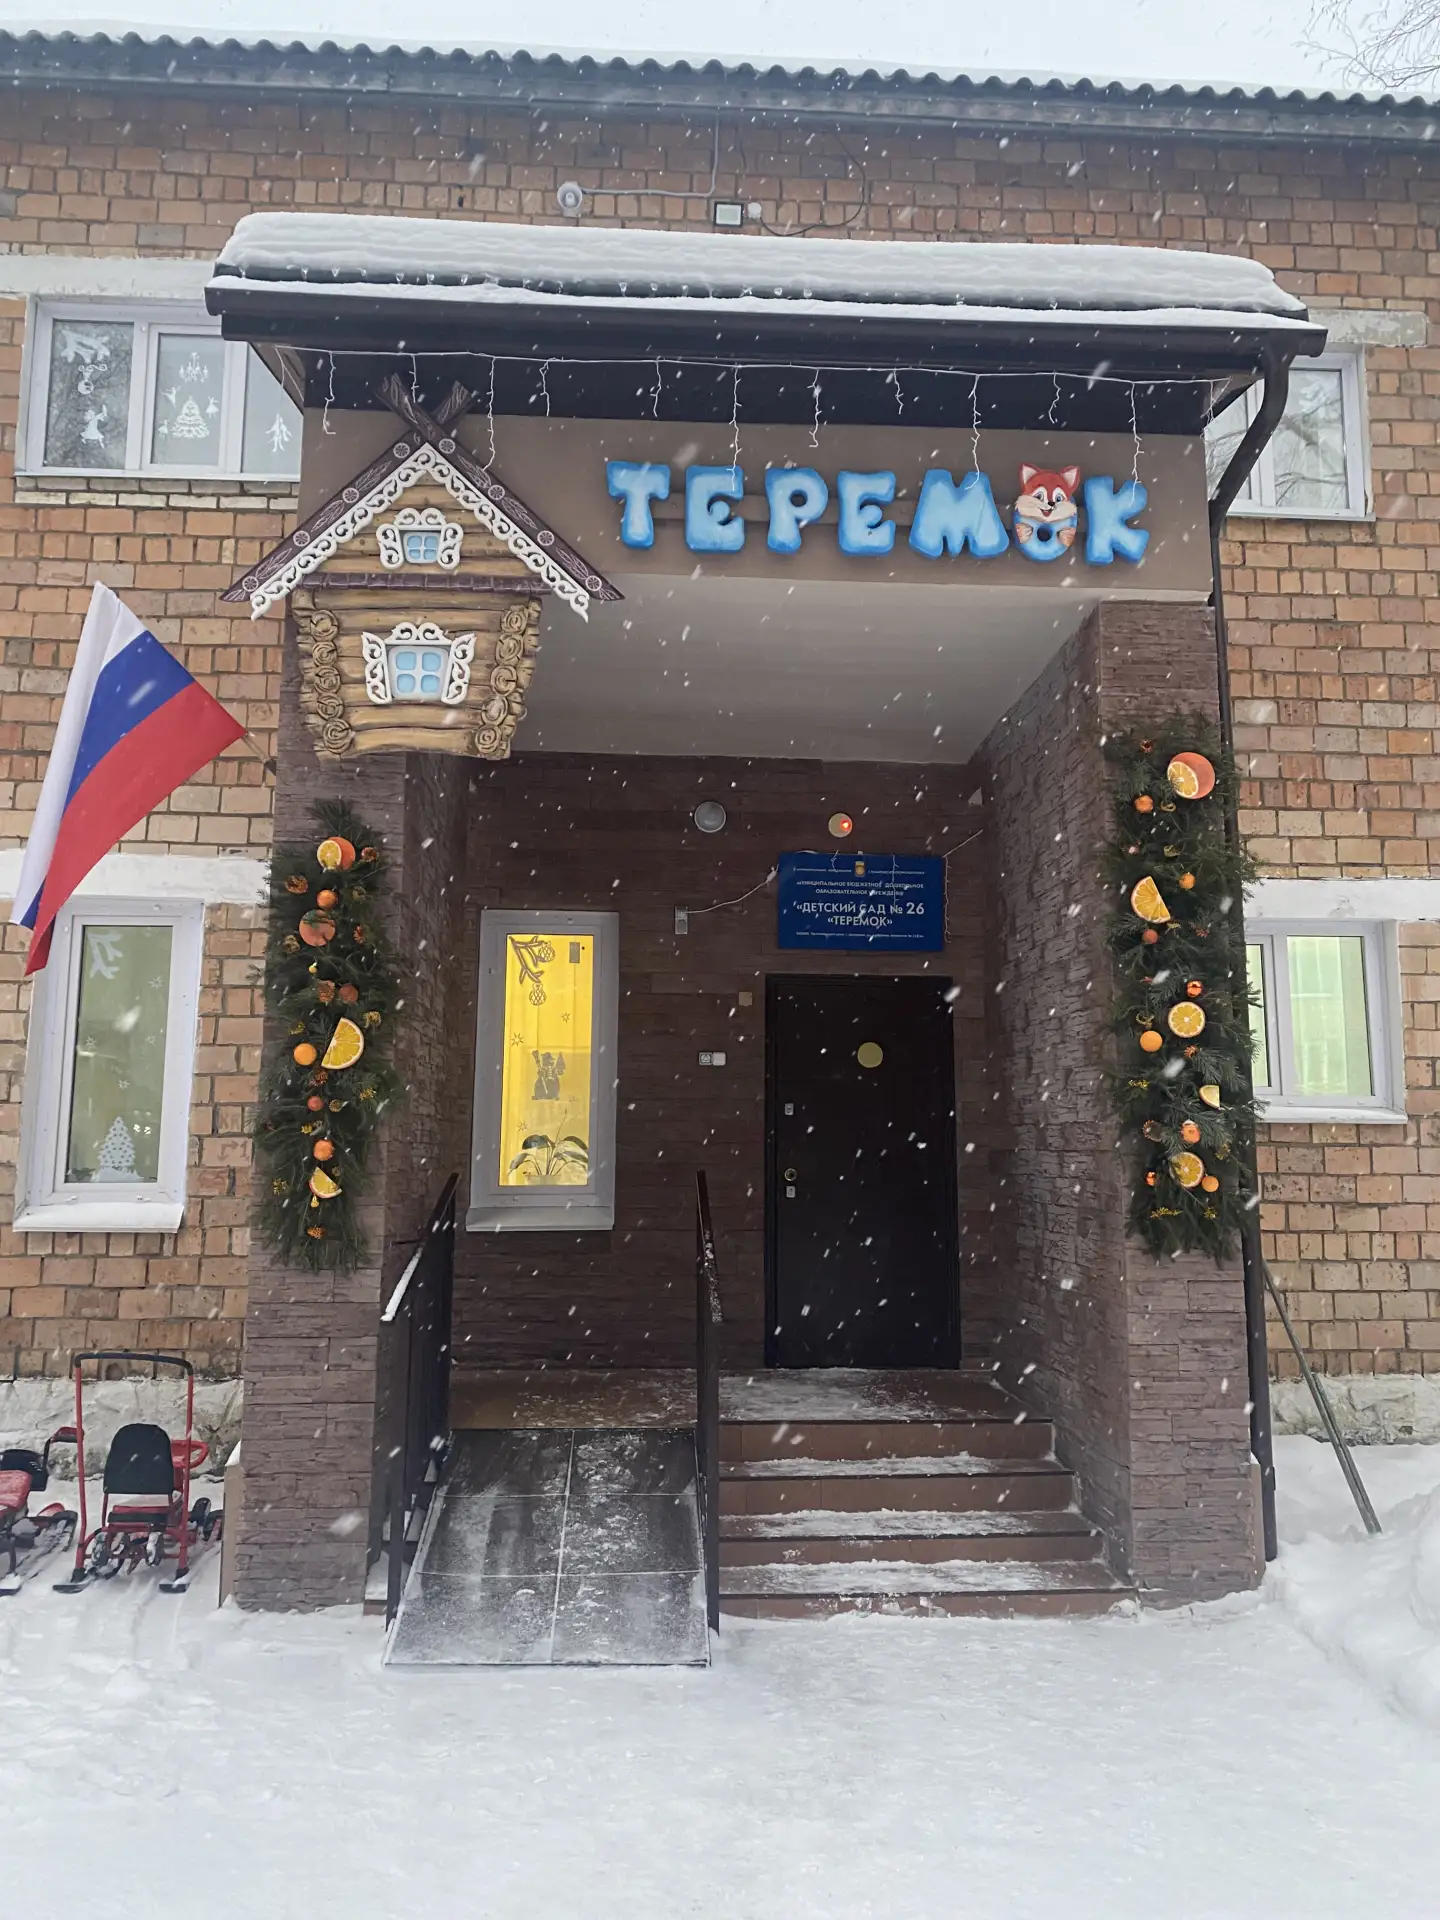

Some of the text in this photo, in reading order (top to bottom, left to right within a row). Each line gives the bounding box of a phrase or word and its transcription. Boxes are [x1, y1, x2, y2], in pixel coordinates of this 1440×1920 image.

[606, 461, 1151, 565] ТЕРЕМОК
[796, 902, 925, 915] «ДЕТСКИЙ САД № 26
[827, 915, 893, 927] «ТЕРЕМОК»
